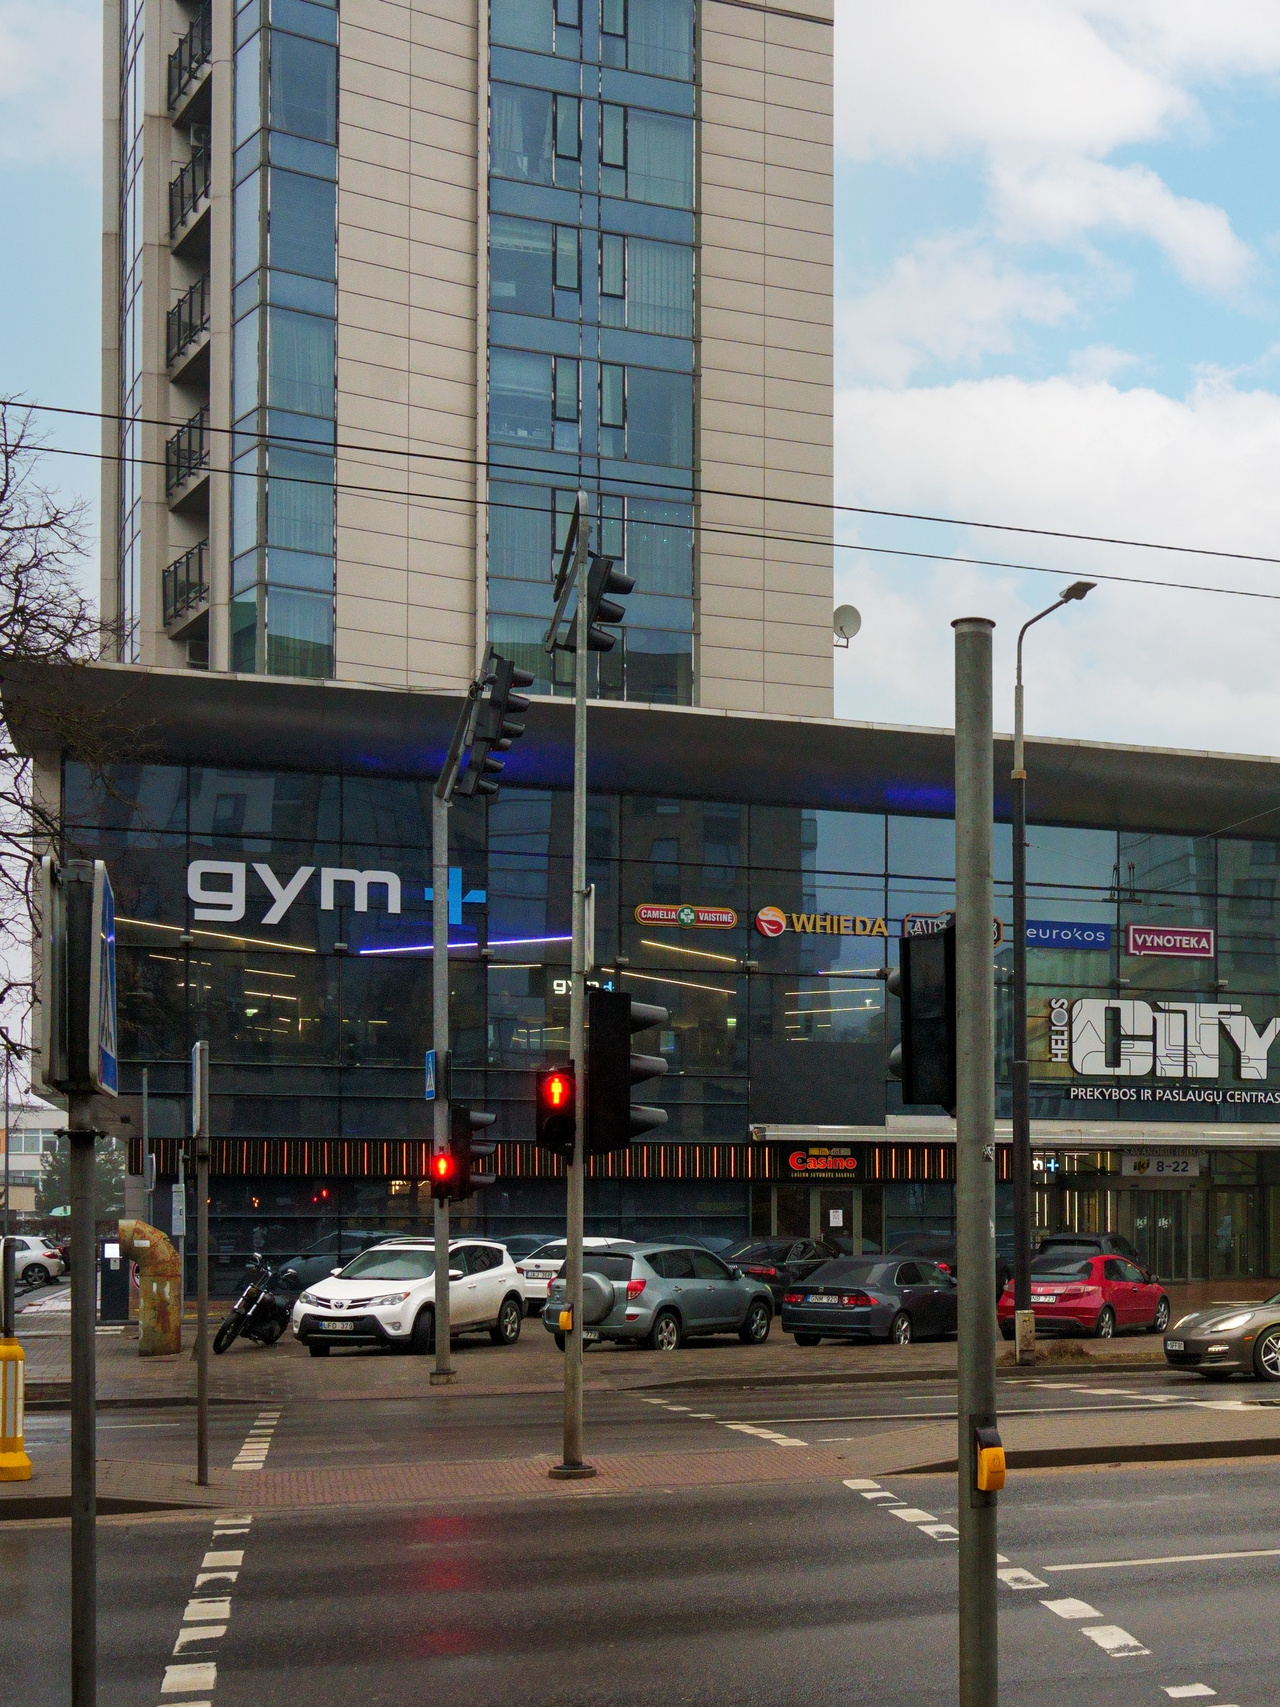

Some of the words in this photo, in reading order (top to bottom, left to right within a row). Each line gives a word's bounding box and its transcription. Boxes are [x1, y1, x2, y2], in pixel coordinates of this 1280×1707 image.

[187, 859, 401, 925] gym
[641, 909, 677, 920] CAMELIA
[698, 911, 733, 923] VAISTINĖ
[791, 913, 889, 936] WHIEDA
[1134, 933, 1209, 949] VYNOTEKA
[1051, 998, 1069, 1062] HELIOS
[1070, 1087, 1137, 1100] PREKYBOS
[1140, 1089, 1152, 1101] IR
[1156, 1090, 1223, 1105] PASLAUGŲ
[1226, 1091, 1280, 1104] CENTRAS
[788, 1151, 858, 1171] Casino
[1156, 1161, 1189, 1172] 8-22
